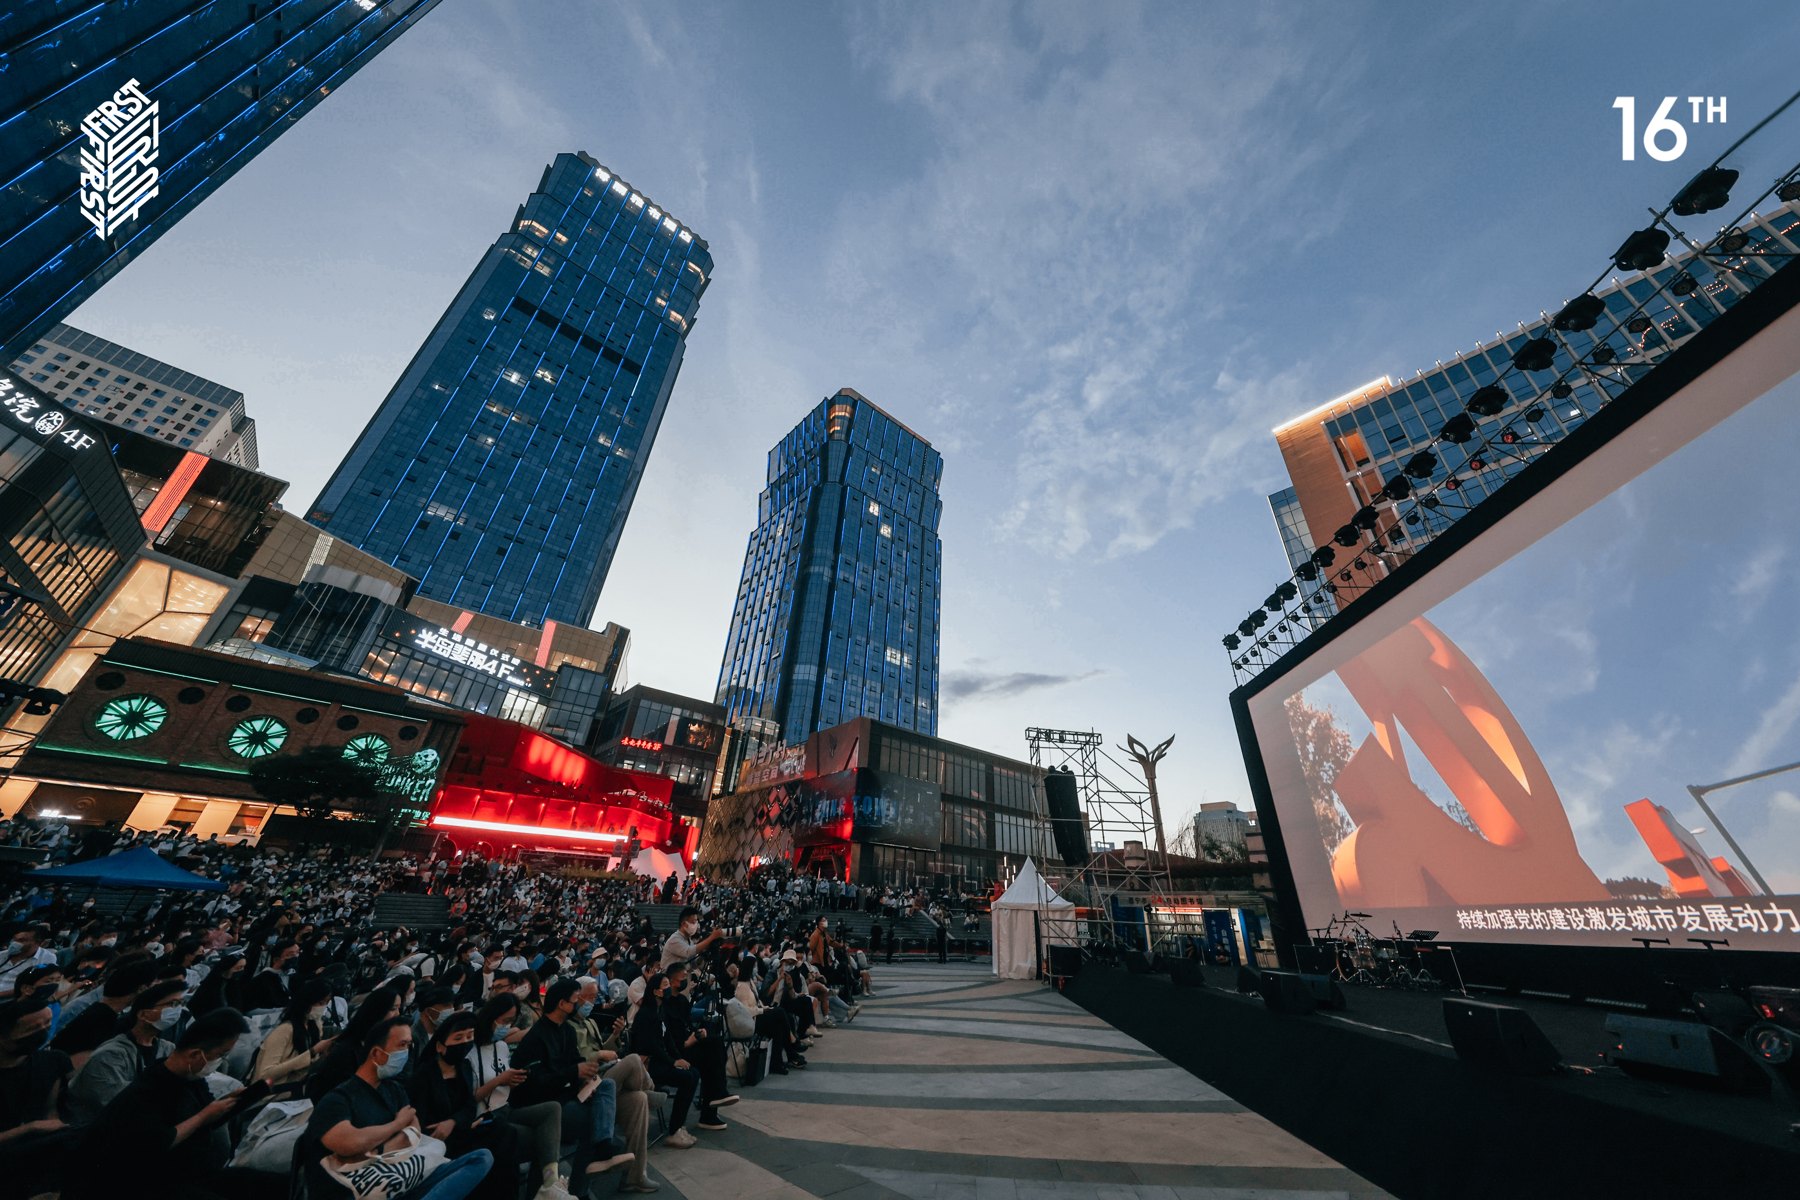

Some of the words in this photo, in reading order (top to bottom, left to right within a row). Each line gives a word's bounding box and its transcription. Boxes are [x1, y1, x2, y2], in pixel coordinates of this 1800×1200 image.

[60, 429, 96, 450] 4F
[1456, 902, 1800, 933] 持续加强党的建设激发城市发展动力
